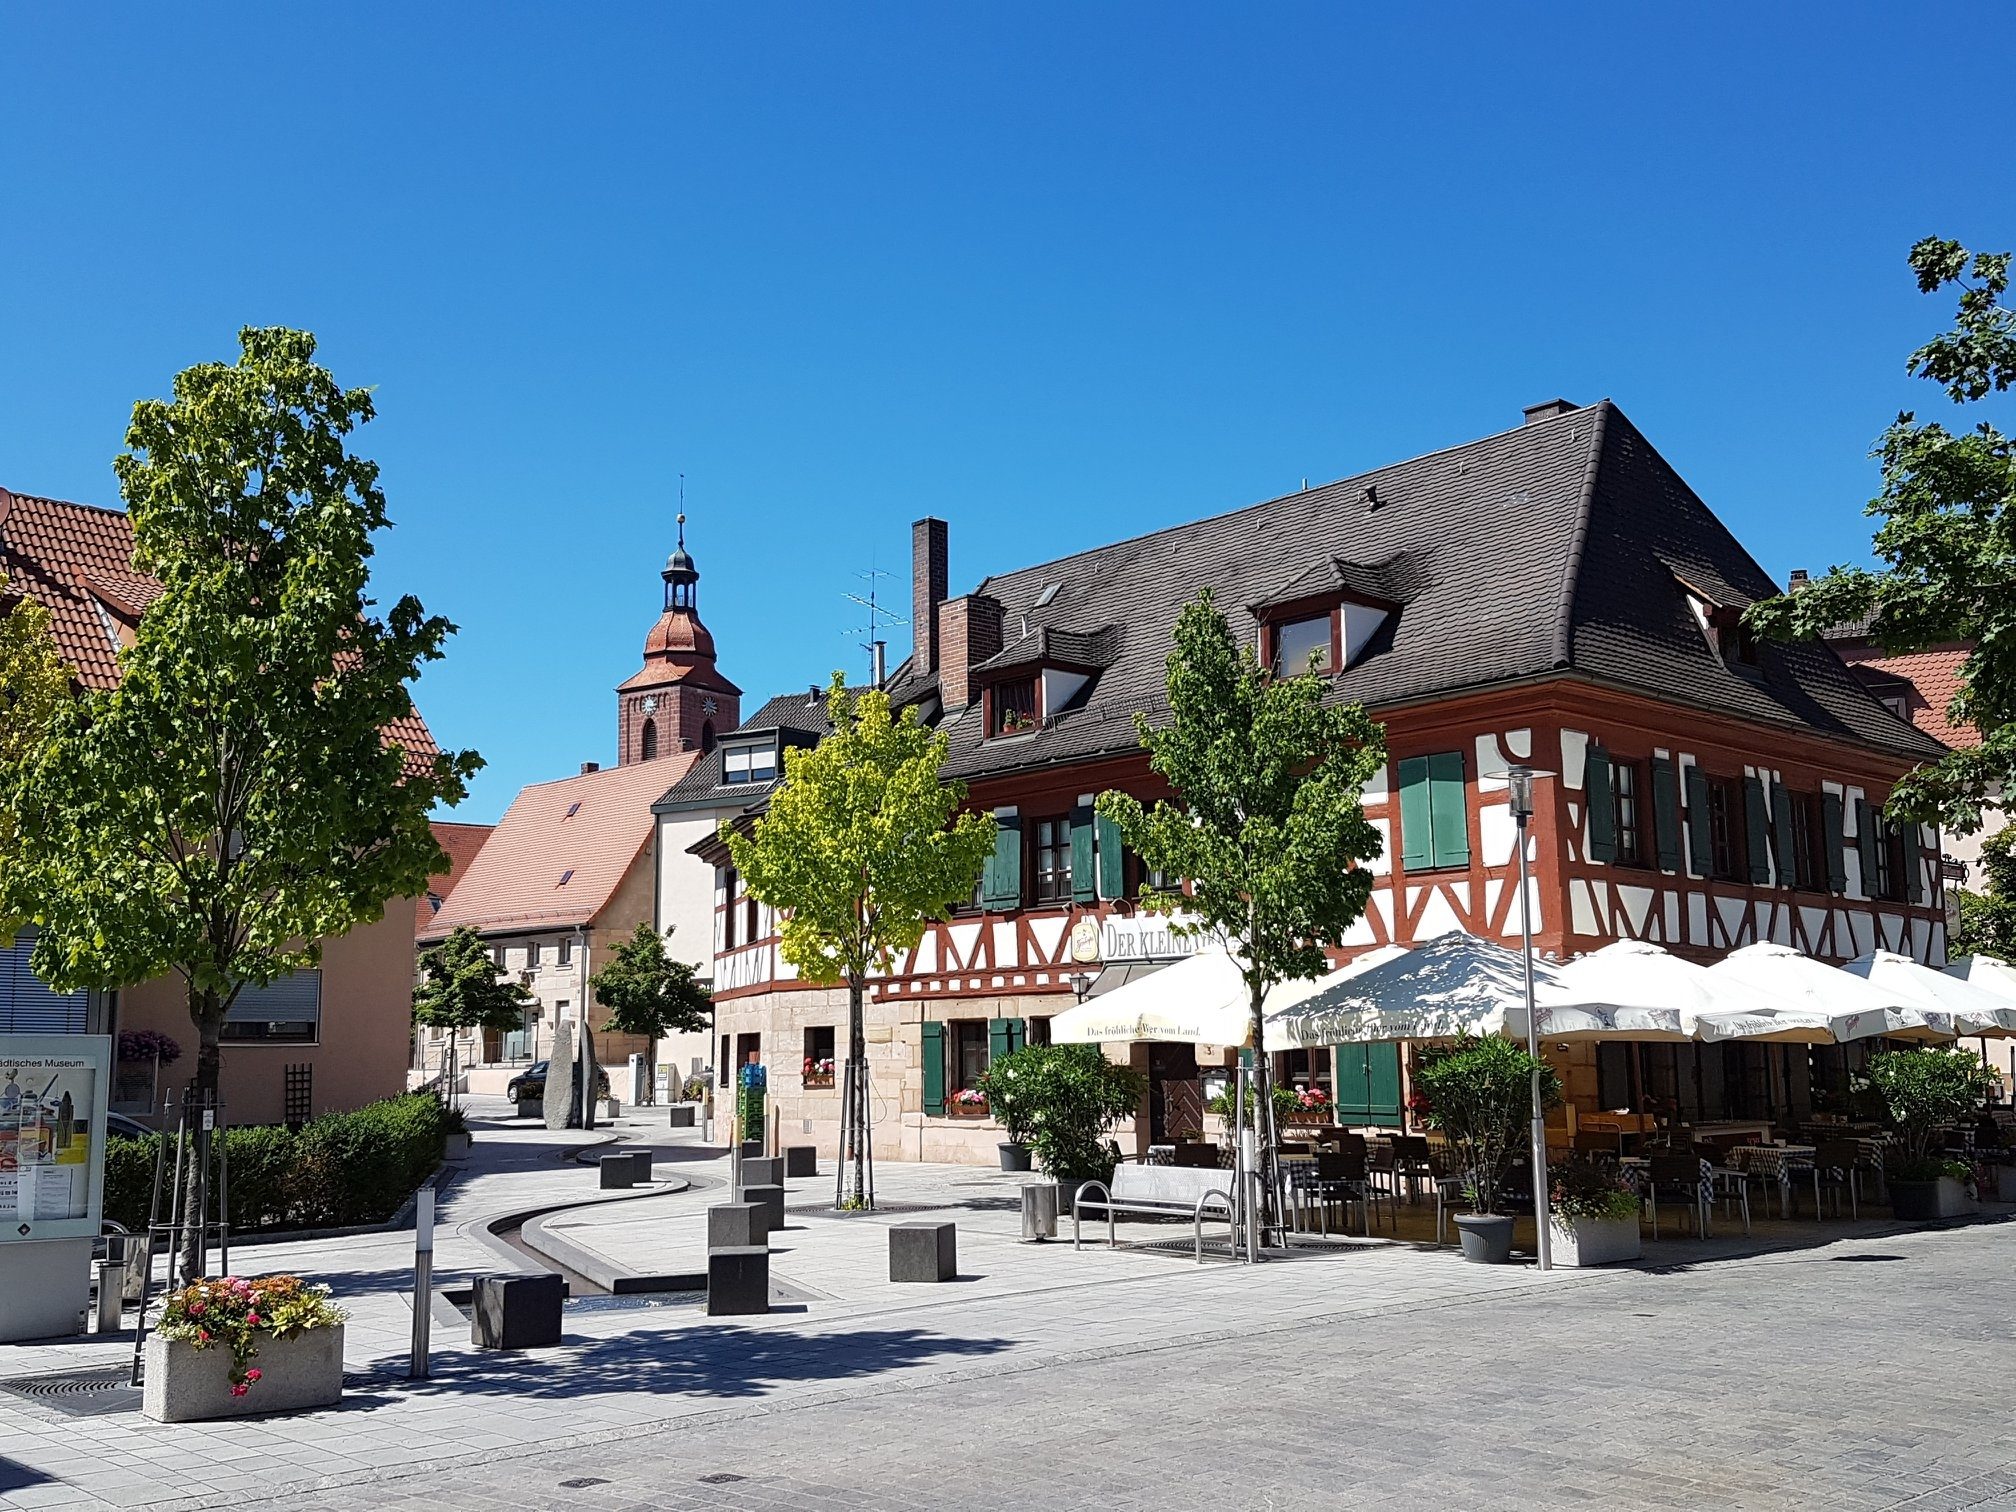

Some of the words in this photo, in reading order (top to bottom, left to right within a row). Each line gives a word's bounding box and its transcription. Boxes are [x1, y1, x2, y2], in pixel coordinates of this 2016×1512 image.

[1106, 923, 1136, 957] DER
[1087, 1026, 1103, 1036] Das
[1160, 1026, 1176, 1035] vom
[1301, 1029, 1319, 1040] Das
[1389, 1023, 1410, 1032] vom
[45, 1059, 84, 1067] Museum
